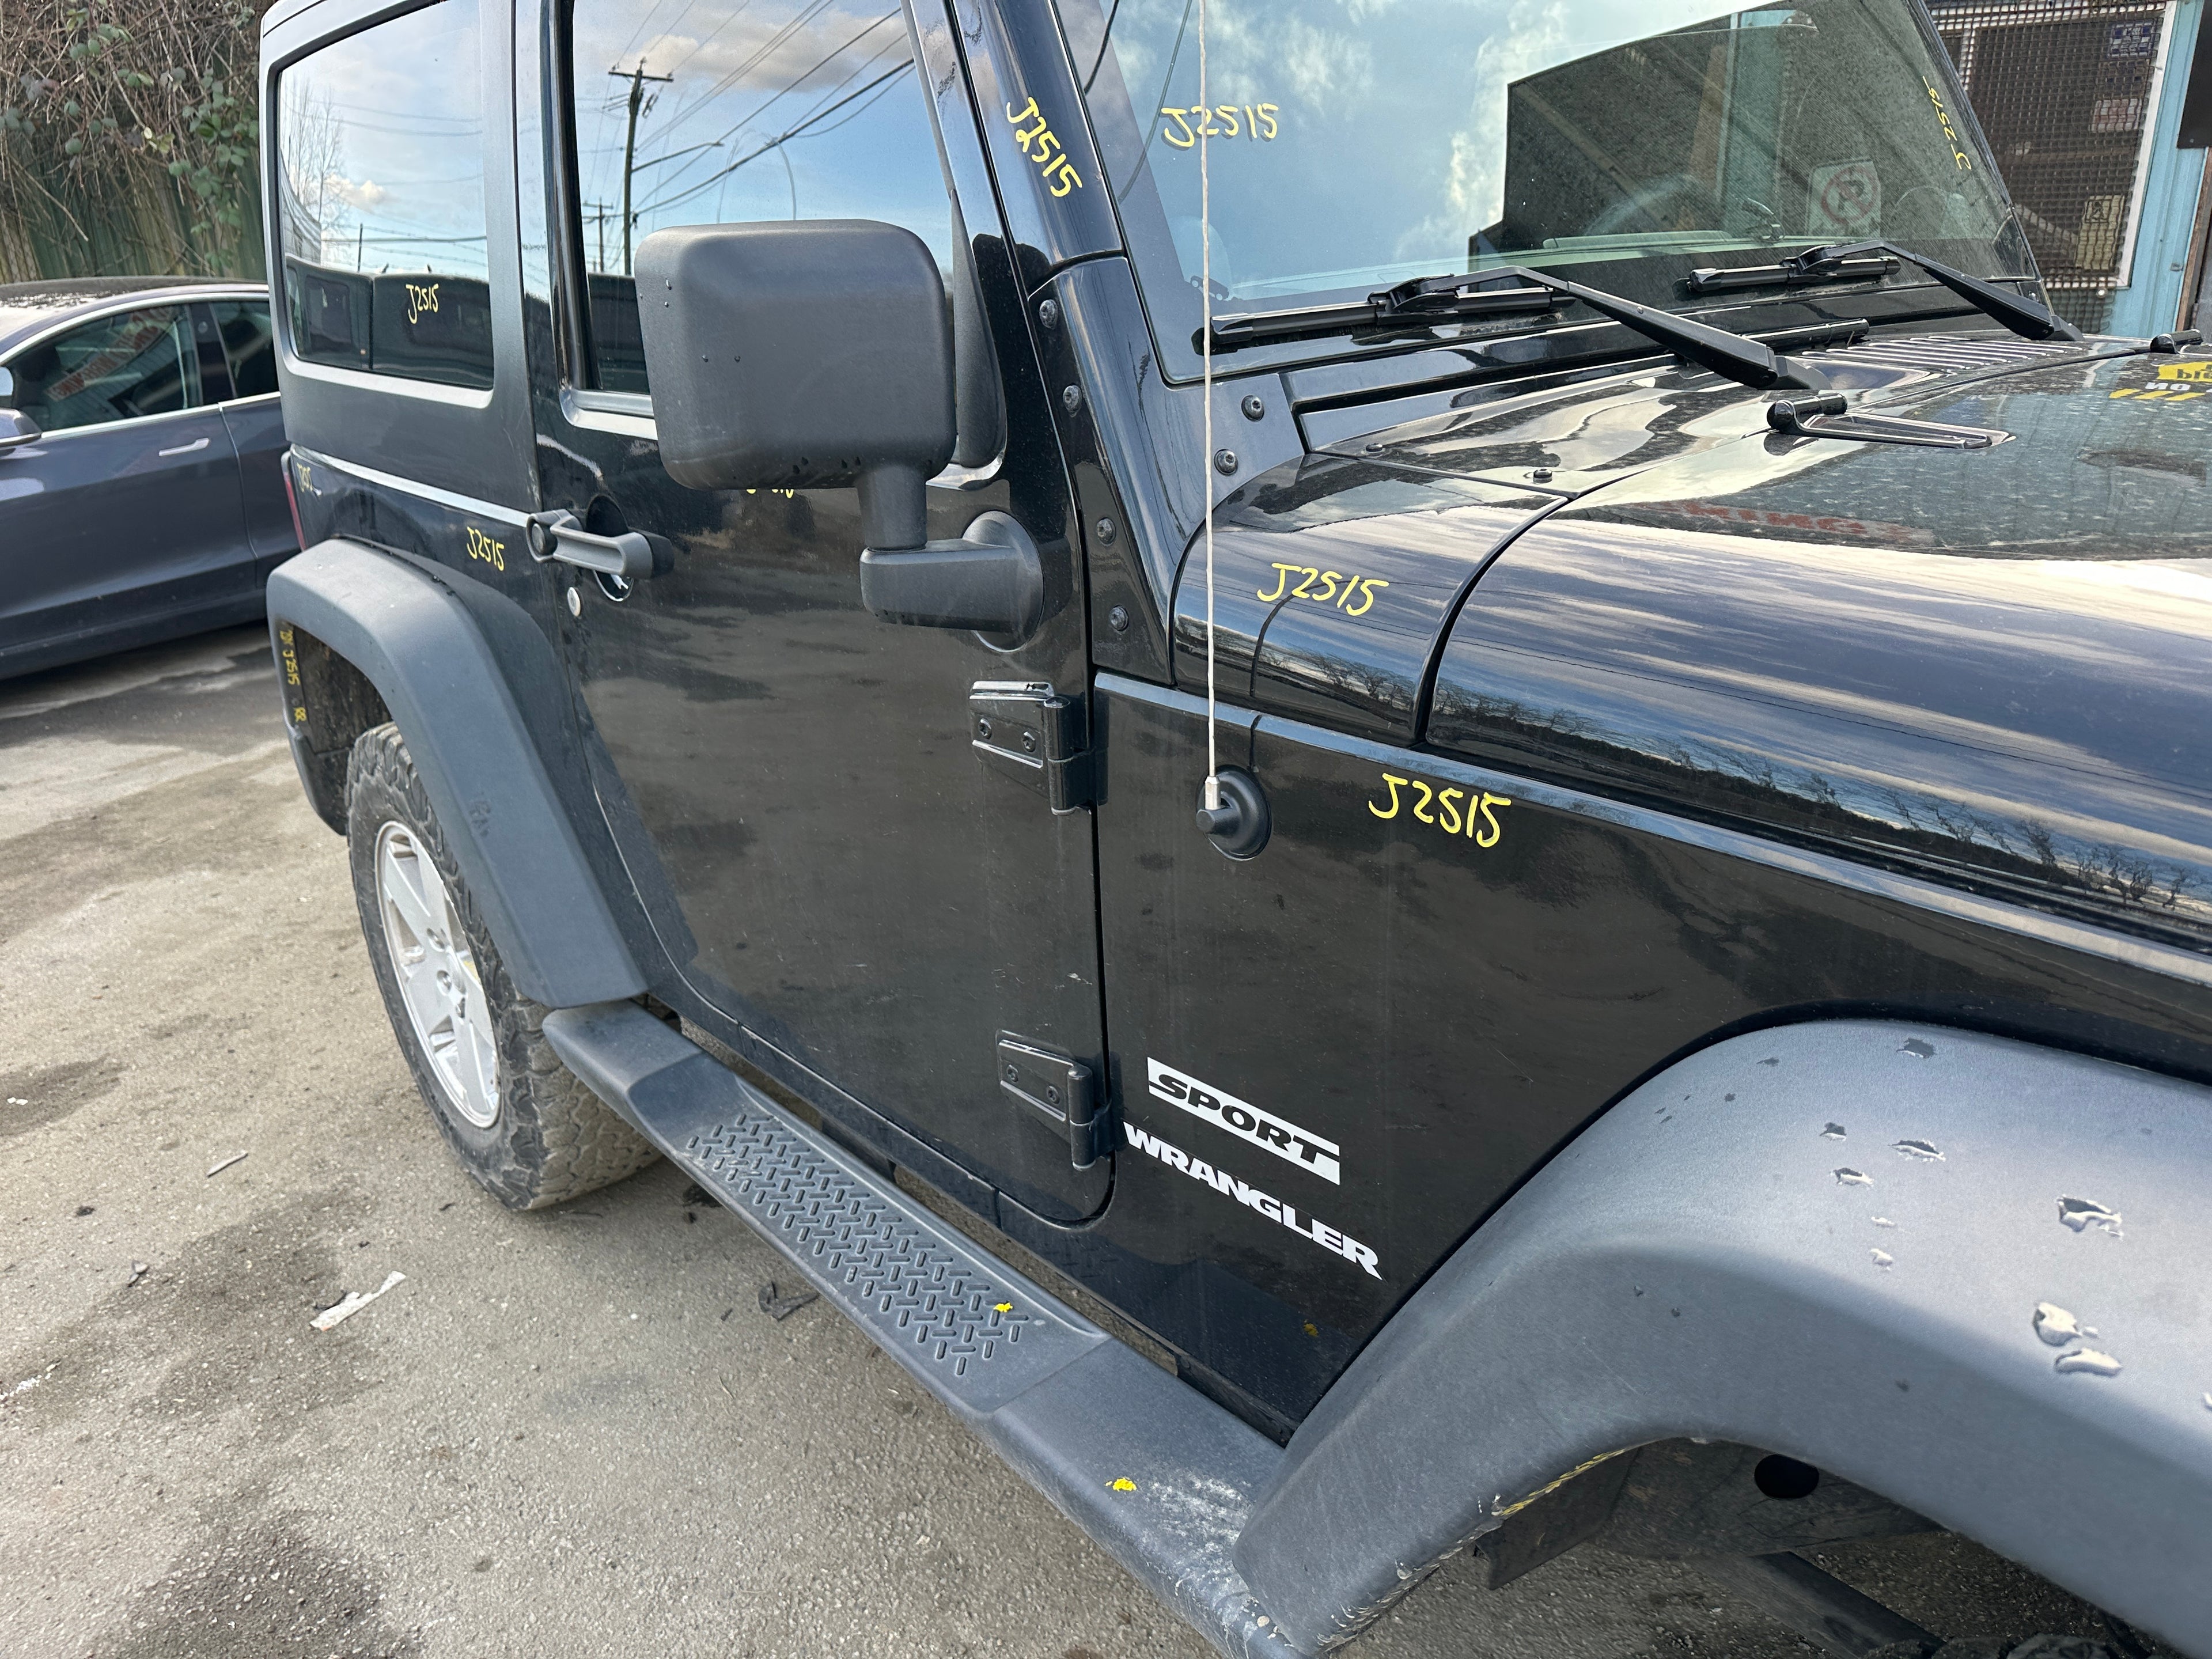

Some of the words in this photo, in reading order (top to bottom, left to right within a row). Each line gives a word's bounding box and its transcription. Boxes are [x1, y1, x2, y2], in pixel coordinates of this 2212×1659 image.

[1006, 96, 1082, 197] J2515
[1161, 103, 1279, 147] J2515
[405, 283, 439, 324] J2515
[466, 525, 505, 571] J2515
[1257, 562, 1389, 616] J2515
[1368, 772, 1512, 848] J2515
[1148, 1073, 1340, 1165] SPORT
[1123, 1121, 1384, 1281] WRANGLER
